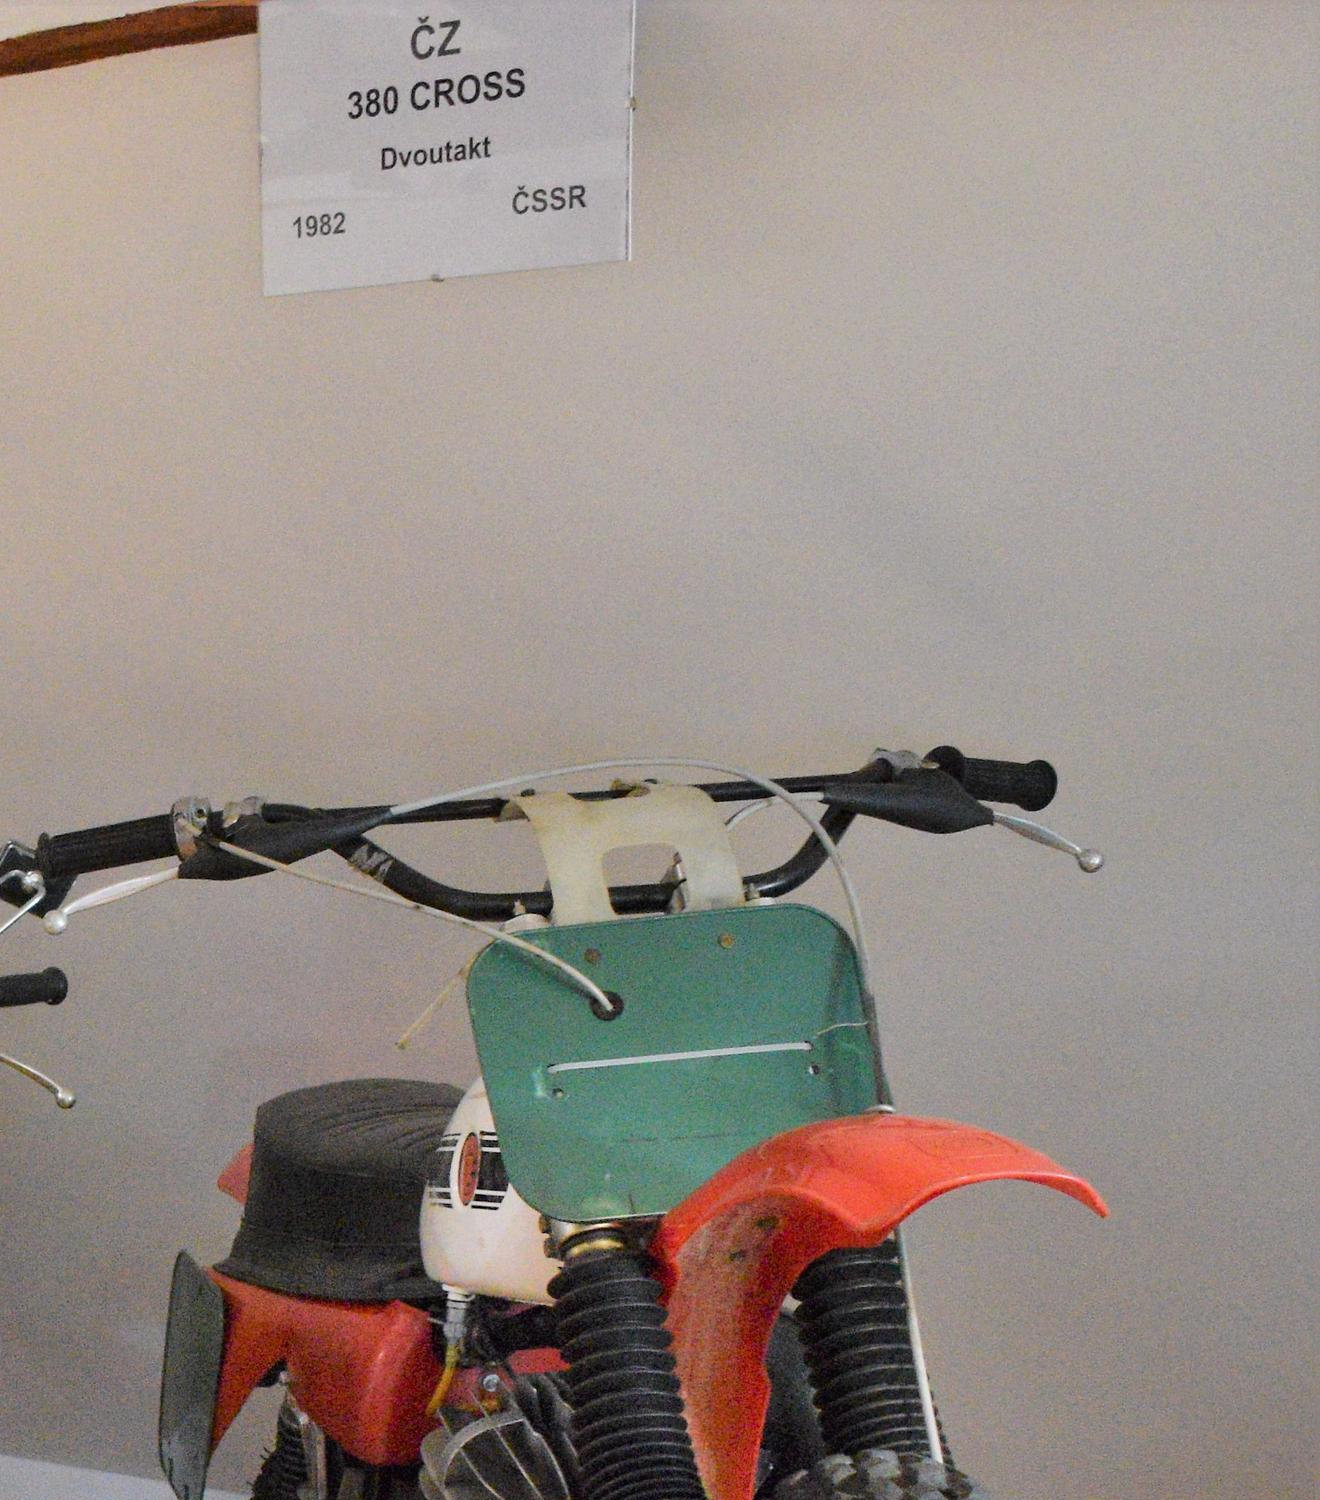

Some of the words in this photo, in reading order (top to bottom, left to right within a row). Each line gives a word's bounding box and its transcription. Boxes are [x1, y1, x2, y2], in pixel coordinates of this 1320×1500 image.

[409, 16, 462, 60] ČZ
[347, 85, 400, 121] 380
[409, 67, 527, 112] CROSS
[380, 135, 492, 171] Dvoutakt
[511, 183, 588, 215] ČSSR
[291, 211, 347, 239] 1982
